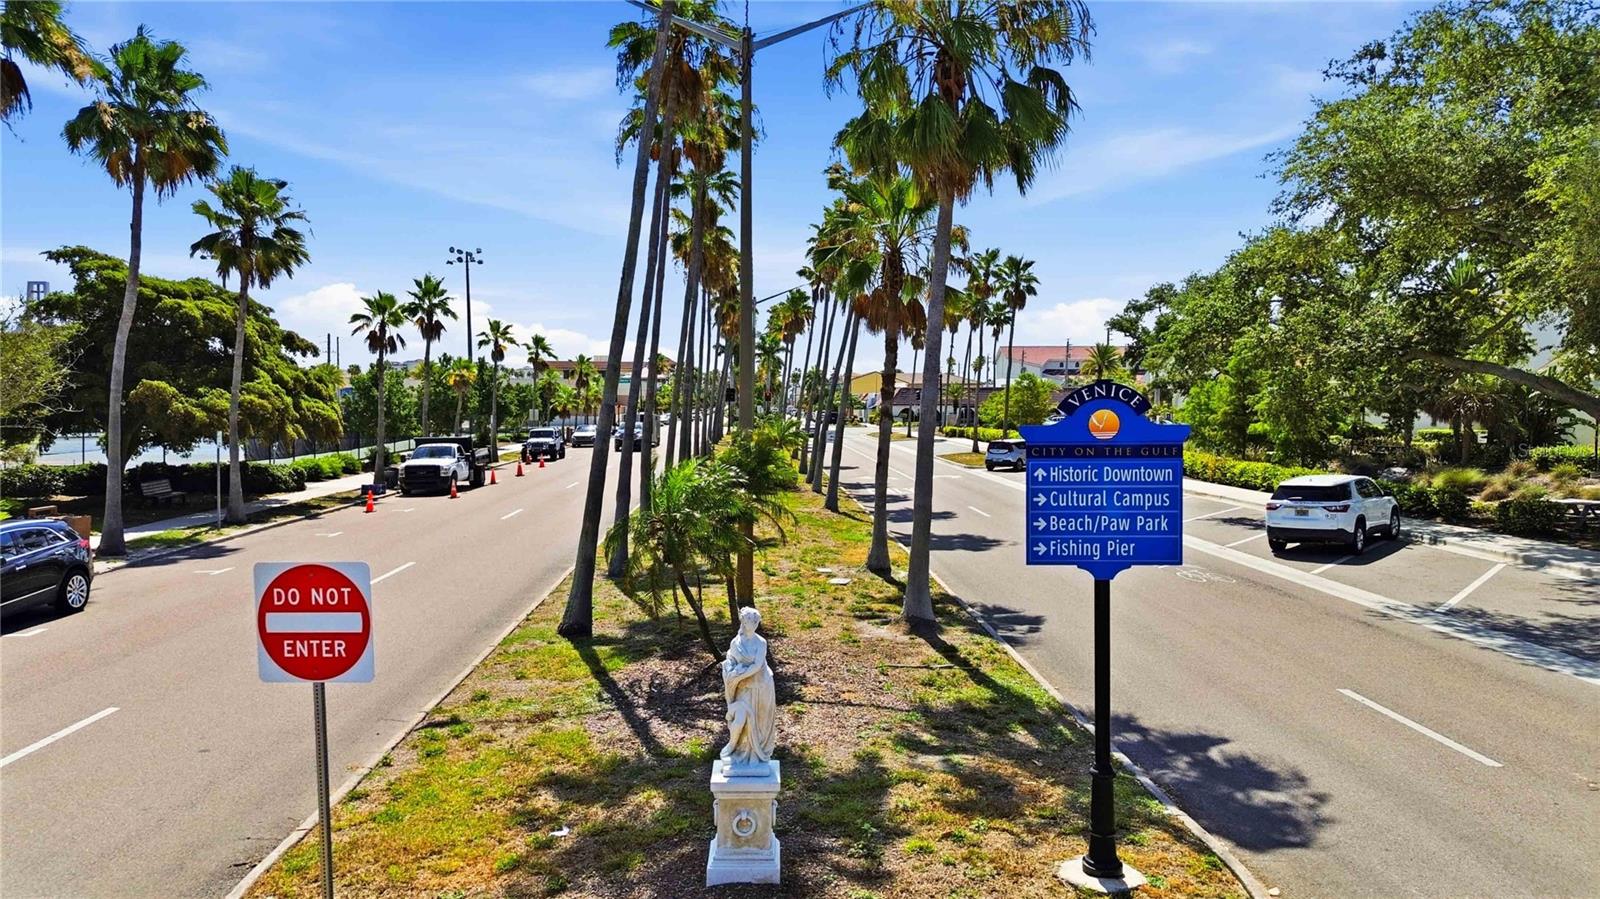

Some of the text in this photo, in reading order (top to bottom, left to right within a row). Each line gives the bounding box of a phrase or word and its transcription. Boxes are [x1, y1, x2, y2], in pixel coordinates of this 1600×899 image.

[1068, 384, 1142, 408] VENICE
[1031, 447, 1179, 457] CITY ON THE GULF
[1049, 466, 1173, 482] Historic Downtown
[1050, 490, 1170, 510] Cultural Campus
[1050, 515, 1168, 533] Beach/Paw Park
[1050, 540, 1135, 560] Fishing Pier
[273, 587, 352, 605] DO NOT
[283, 640, 347, 657] ENTER
